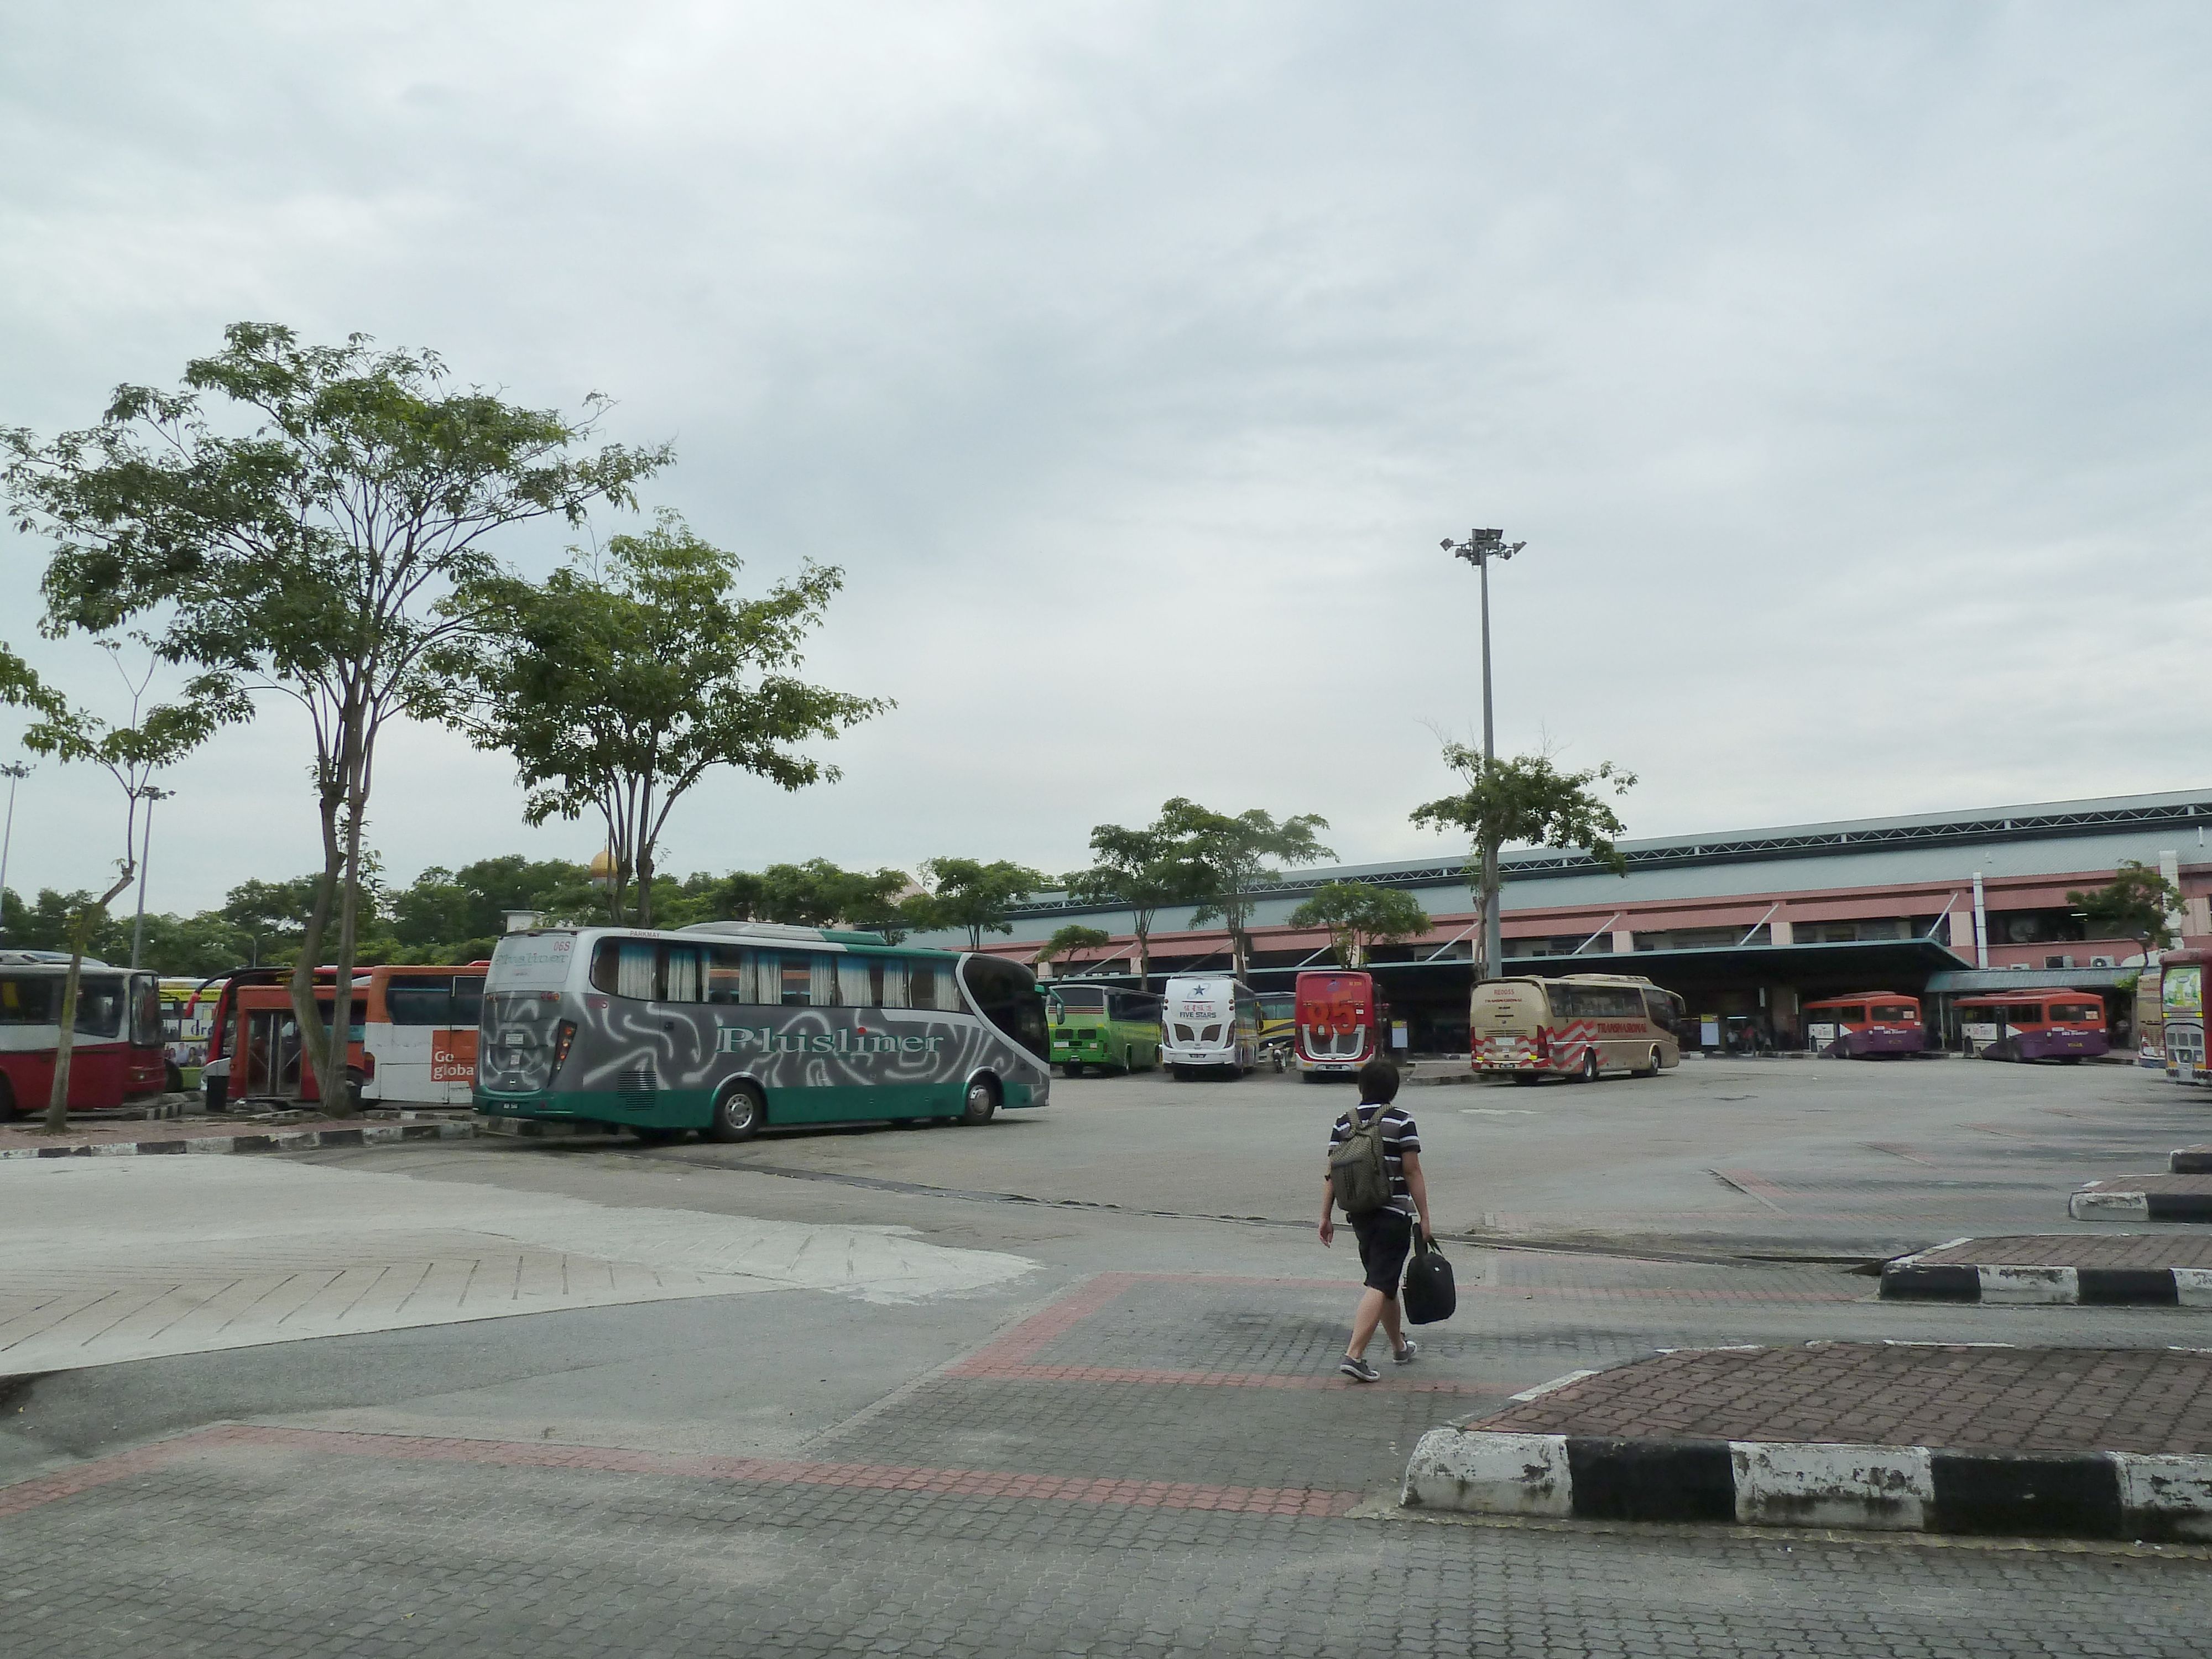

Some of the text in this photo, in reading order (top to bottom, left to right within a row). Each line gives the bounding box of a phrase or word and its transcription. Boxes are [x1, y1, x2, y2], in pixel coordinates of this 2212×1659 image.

[1597, 1023, 1647, 1033] TRANSNASIONAL
[717, 1026, 944, 1053] Plusliner
[435, 1051, 454, 1062] Go
[434, 1063, 476, 1079] globa
